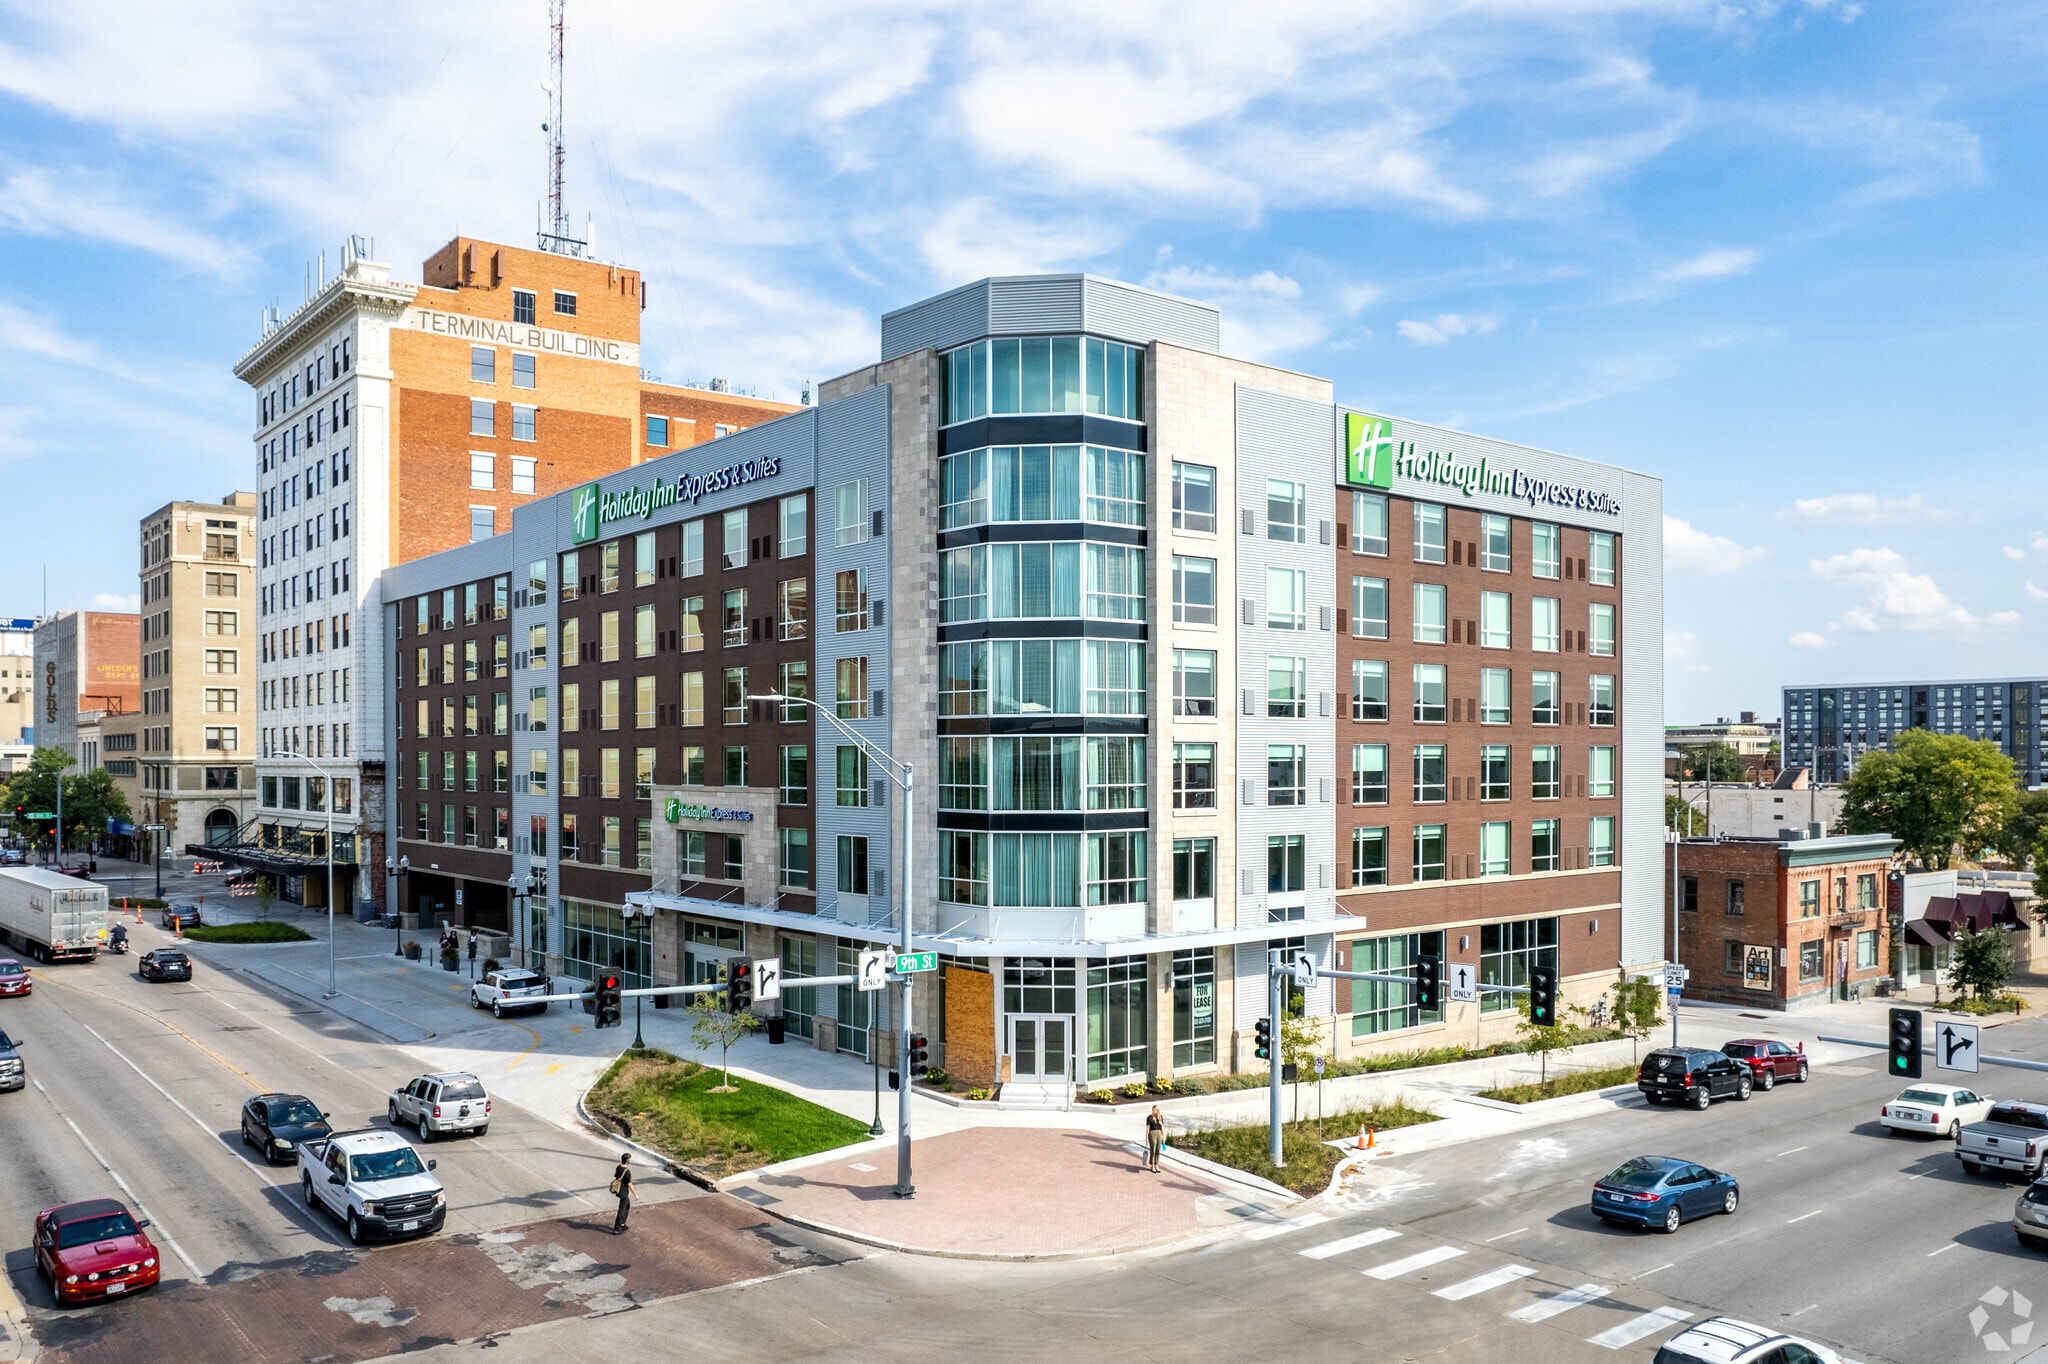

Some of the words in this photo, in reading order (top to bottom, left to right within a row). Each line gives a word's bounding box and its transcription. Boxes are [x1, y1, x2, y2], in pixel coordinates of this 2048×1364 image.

[417, 309, 524, 346] TERMINAL
[527, 328, 620, 361] BUILDING
[1398, 440, 1481, 496] Holiday
[1482, 457, 1513, 495] Inn
[1512, 468, 1577, 508] Express
[1577, 487, 1588, 508] &
[1587, 491, 1623, 515] Suites
[600, 486, 651, 520] Holiday
[651, 477, 678, 509] Inn
[676, 465, 731, 506] Express
[731, 463, 742, 486] &
[742, 456, 781, 483] Suites
[46, 661, 58, 724] GOLDS
[678, 803, 701, 820] Holiday
[700, 805, 711, 819] Inn
[711, 807, 733, 821] Express
[1748, 947, 1769, 959] Art
[900, 955, 918, 971] 9th
[921, 954, 933, 969] St
[862, 978, 881, 987] ONLY
[1297, 975, 1314, 985] ONLY
[1666, 975, 1683, 986] 25
[1196, 984, 1209, 997] FOR
[1453, 988, 1472, 999] ONLY
[1193, 996, 1211, 1009] LEASE
